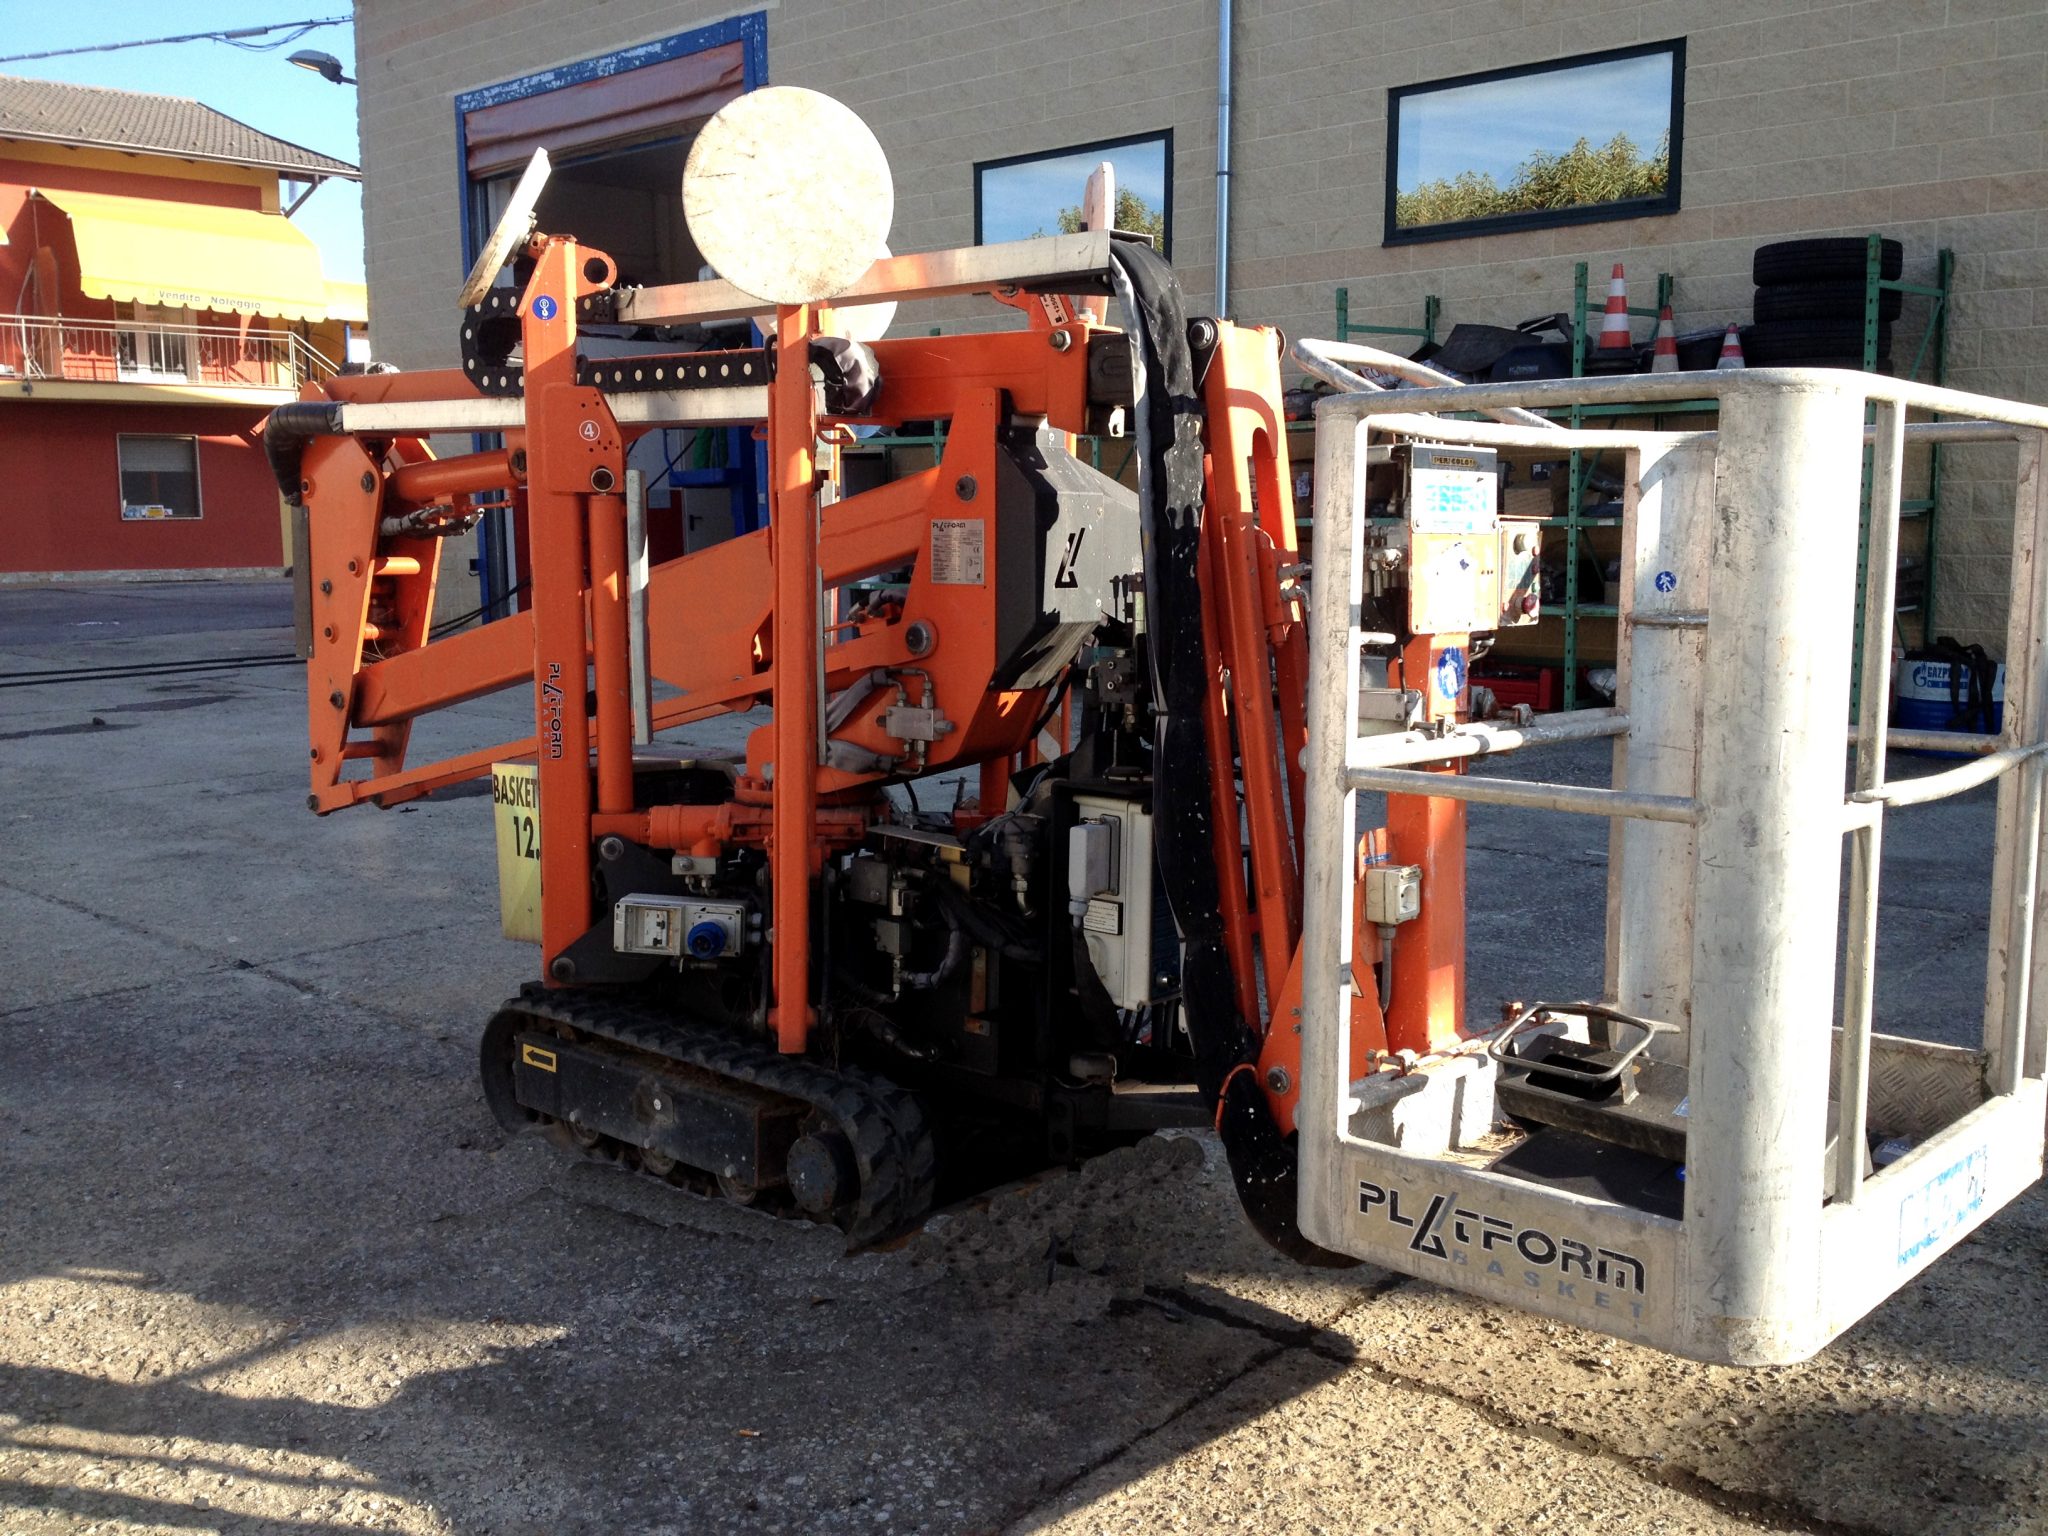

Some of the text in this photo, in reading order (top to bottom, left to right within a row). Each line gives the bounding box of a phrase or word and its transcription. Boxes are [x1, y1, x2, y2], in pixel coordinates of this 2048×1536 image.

[211, 297, 261, 310] Noleggio
[584, 423, 594, 438] 4
[932, 522, 966, 532] PLATFORM
[542, 663, 563, 760] PLATFORM
[493, 775, 537, 808] BASKET
[1358, 1180, 1647, 1297] PLATFORM
[1451, 1248, 1645, 1319] BASKET
